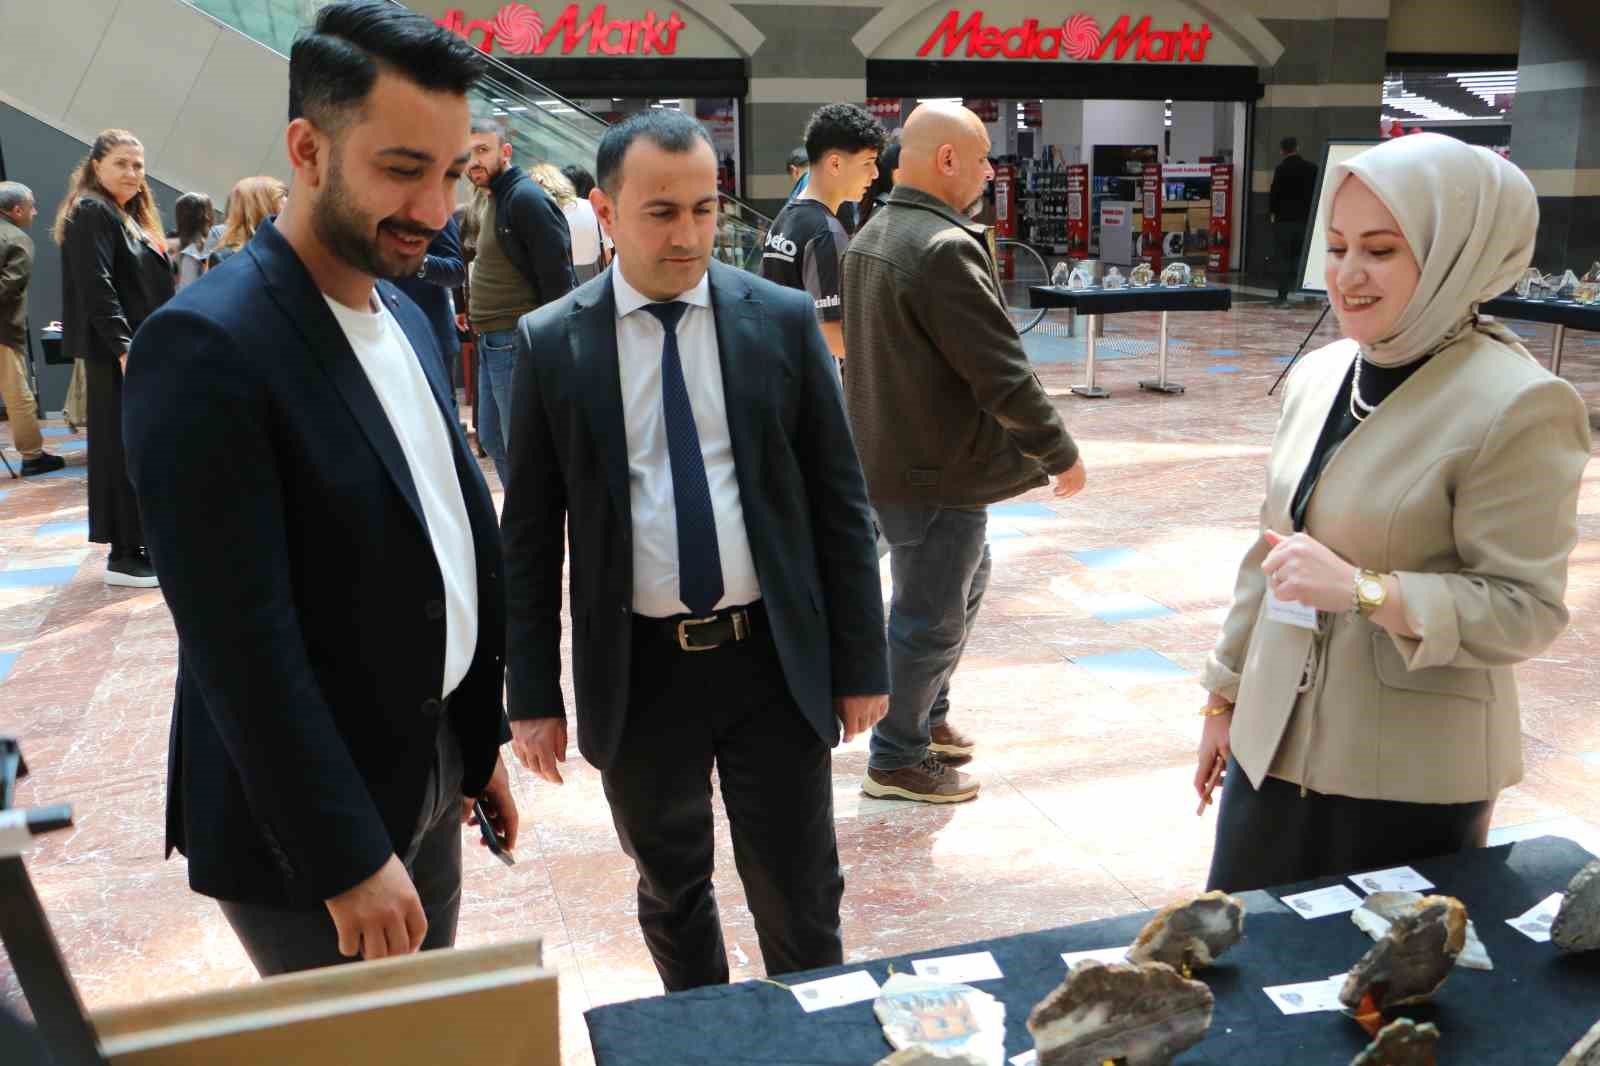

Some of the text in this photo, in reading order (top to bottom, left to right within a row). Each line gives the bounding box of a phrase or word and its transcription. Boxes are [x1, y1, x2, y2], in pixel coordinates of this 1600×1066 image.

[533, 3, 685, 55] Markt
[916, 9, 1213, 62] Media Markt
